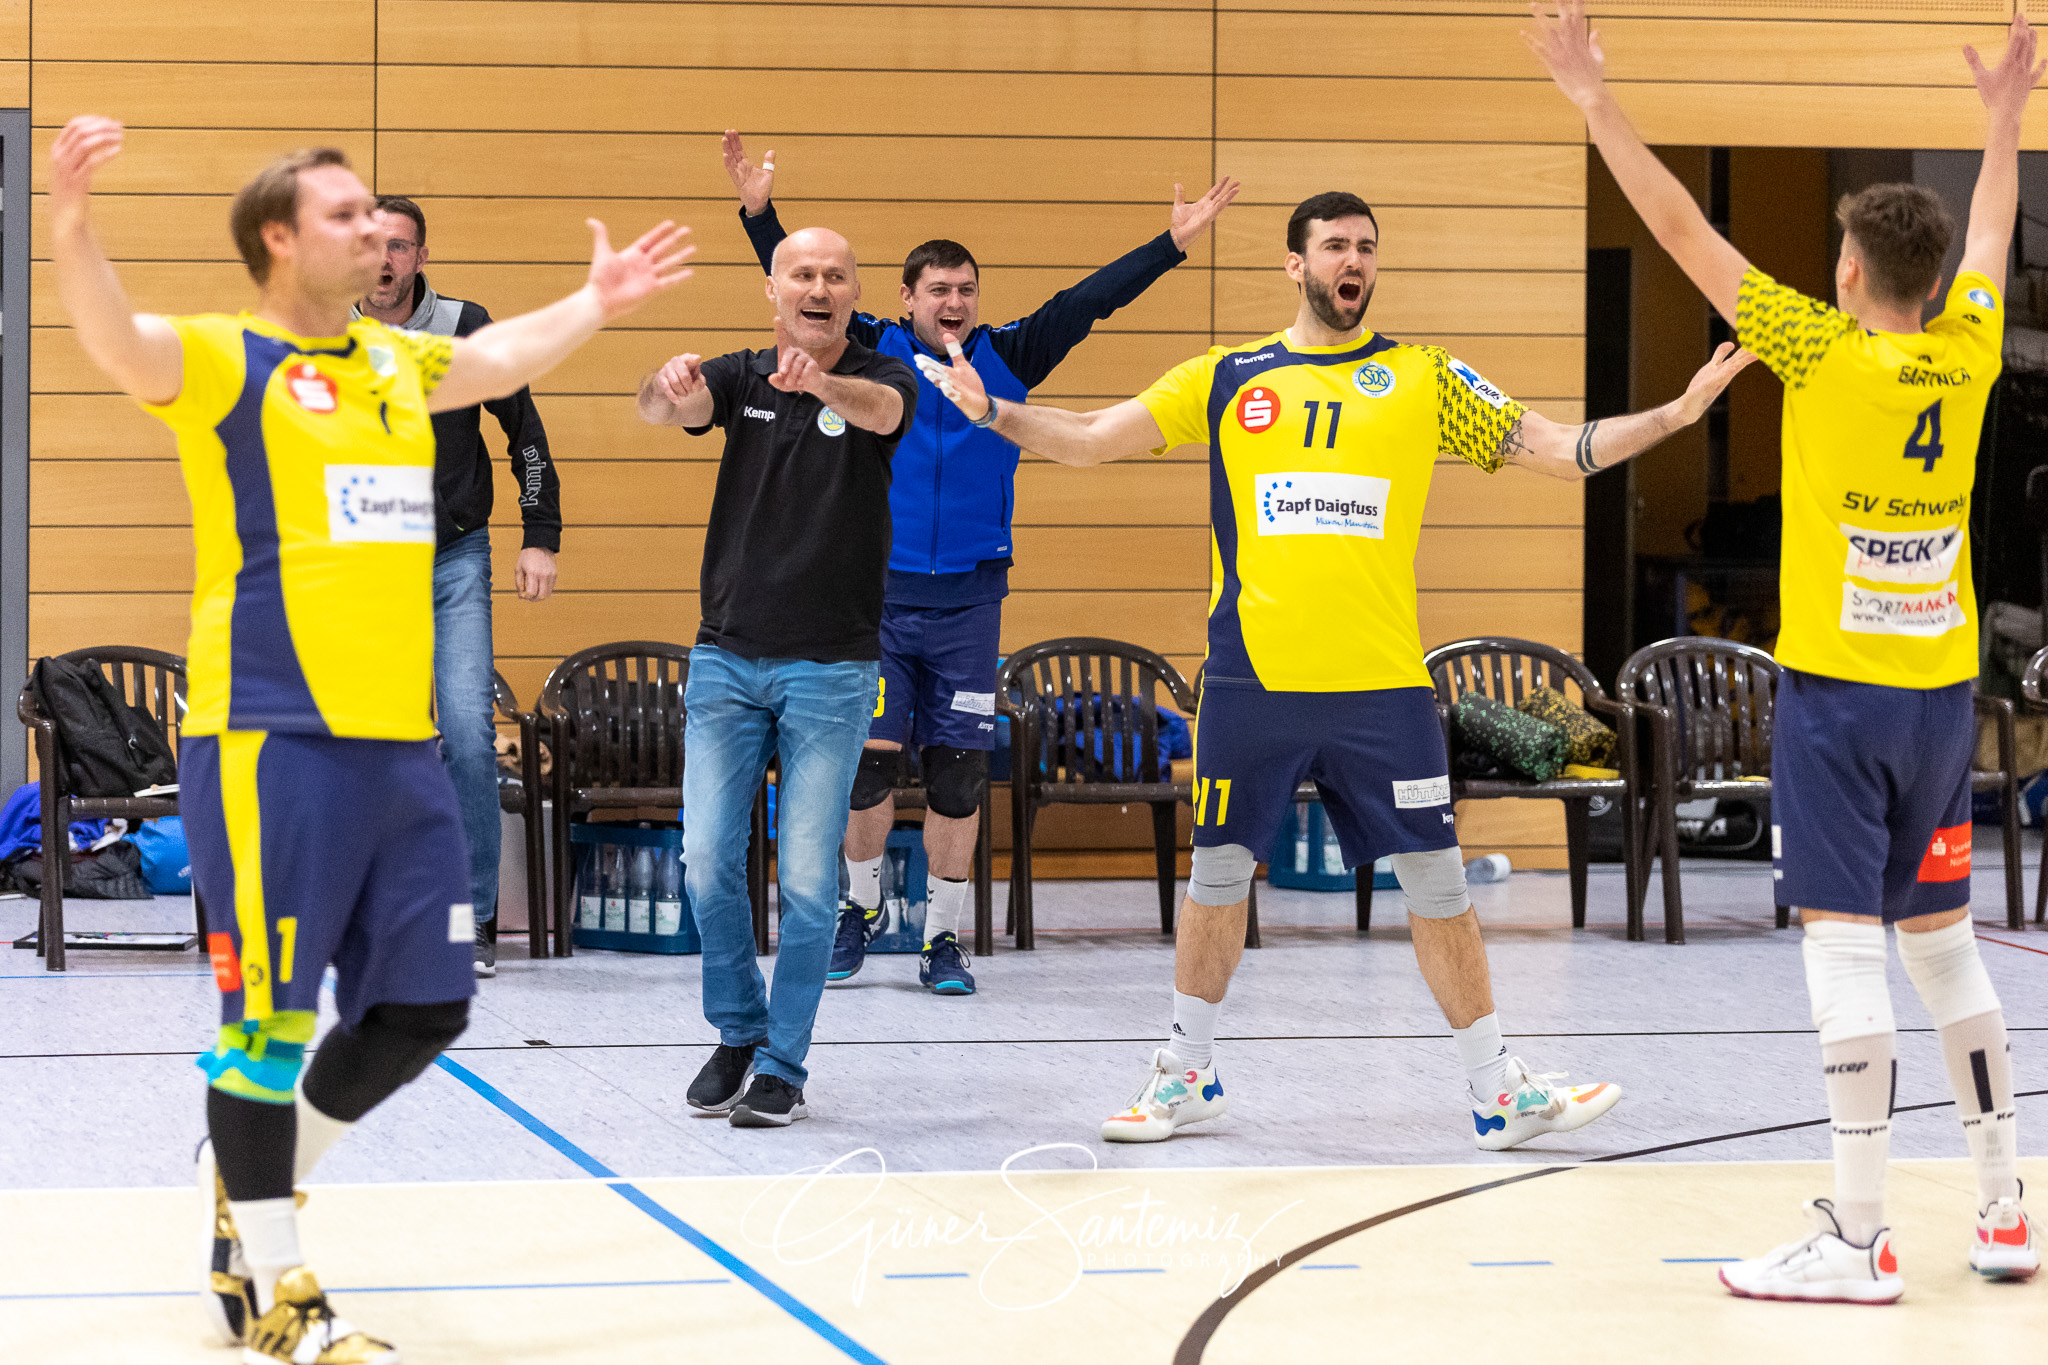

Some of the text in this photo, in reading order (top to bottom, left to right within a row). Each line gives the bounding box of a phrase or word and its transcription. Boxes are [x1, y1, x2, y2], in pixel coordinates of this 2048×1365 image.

[1235, 352, 1275, 366] Kempa
[743, 405, 776, 422] Kemp
[1303, 400, 1343, 449] 11
[1903, 397, 1944, 473] 4
[1276, 498, 1378, 517] Zapf Daigfuss
[1842, 491, 1879, 513] SV
[1849, 534, 1935, 564] SPECK
[276, 916, 298, 984] 1
